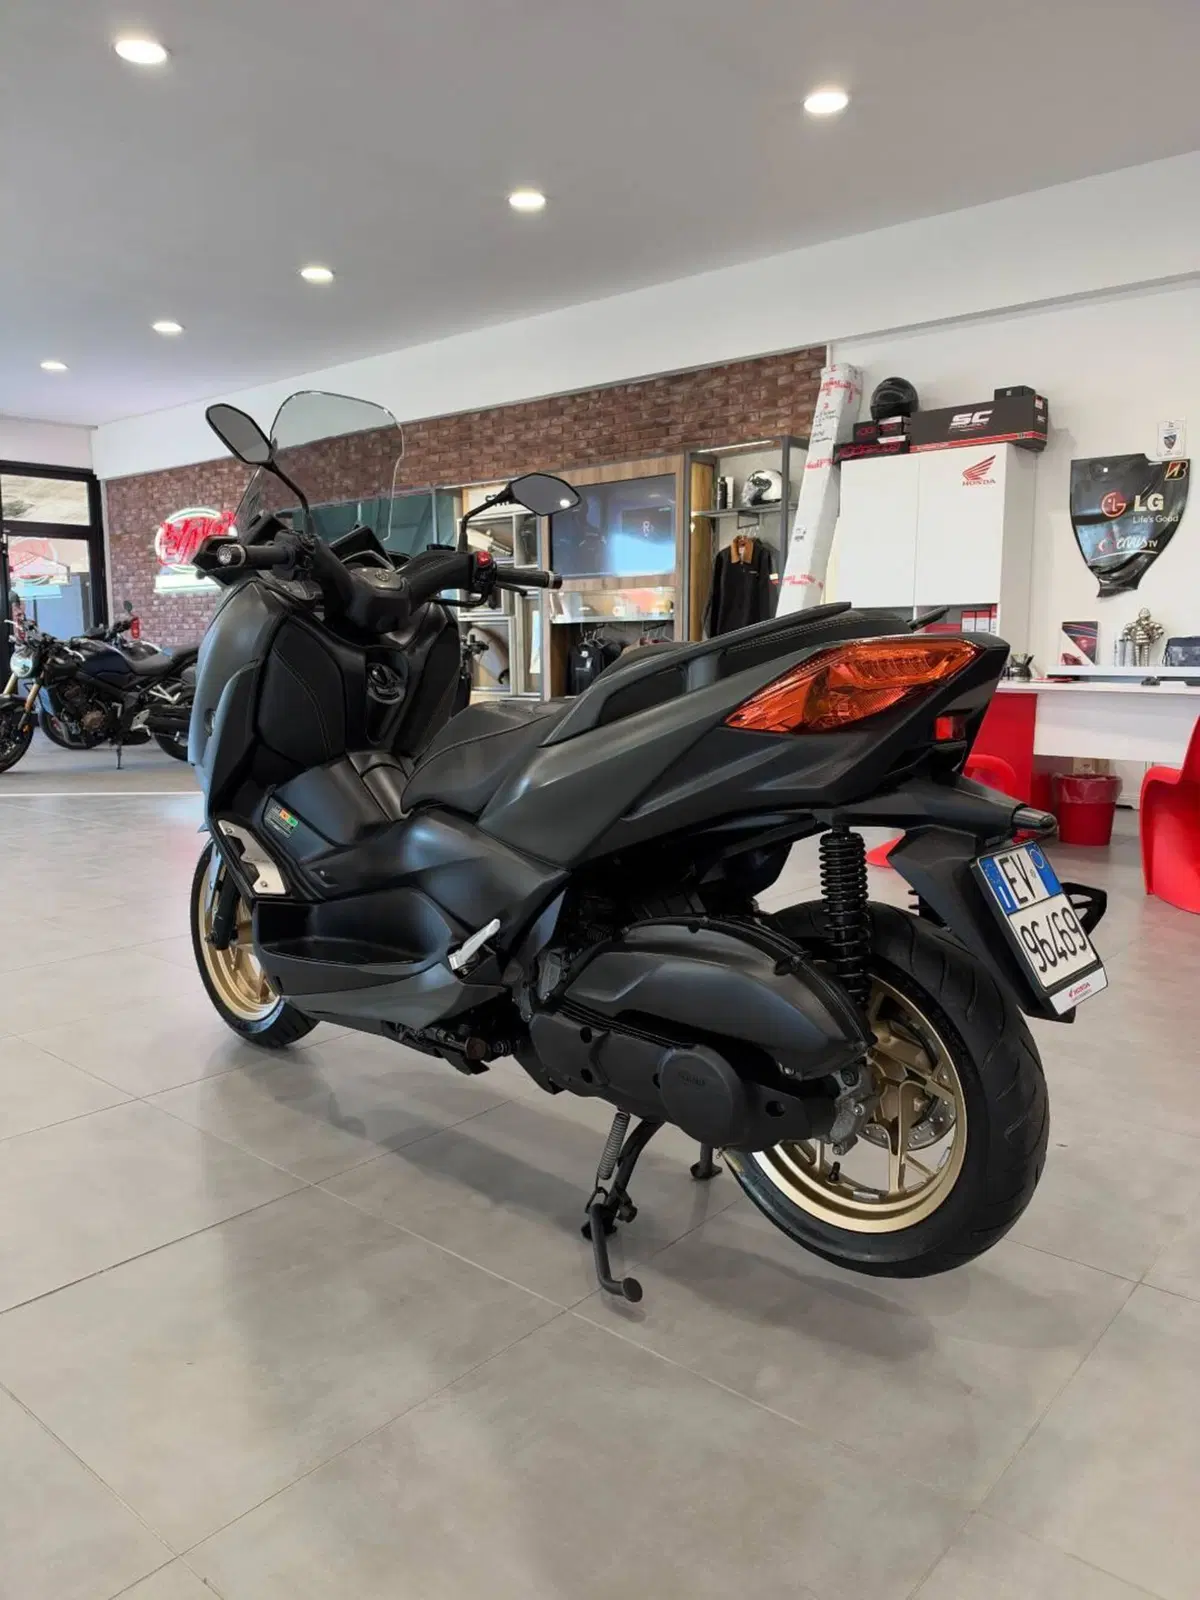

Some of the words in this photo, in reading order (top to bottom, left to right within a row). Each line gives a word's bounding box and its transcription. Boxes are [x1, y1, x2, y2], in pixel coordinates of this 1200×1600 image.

[951, 409, 994, 426] SC
[962, 478, 996, 487] HONDA
[1133, 493, 1164, 512] LG
[1132, 515, 1154, 525] Life's
[1155, 514, 1179, 523] Good
[997, 853, 1036, 905] EV
[1020, 907, 1087, 973] 96469
